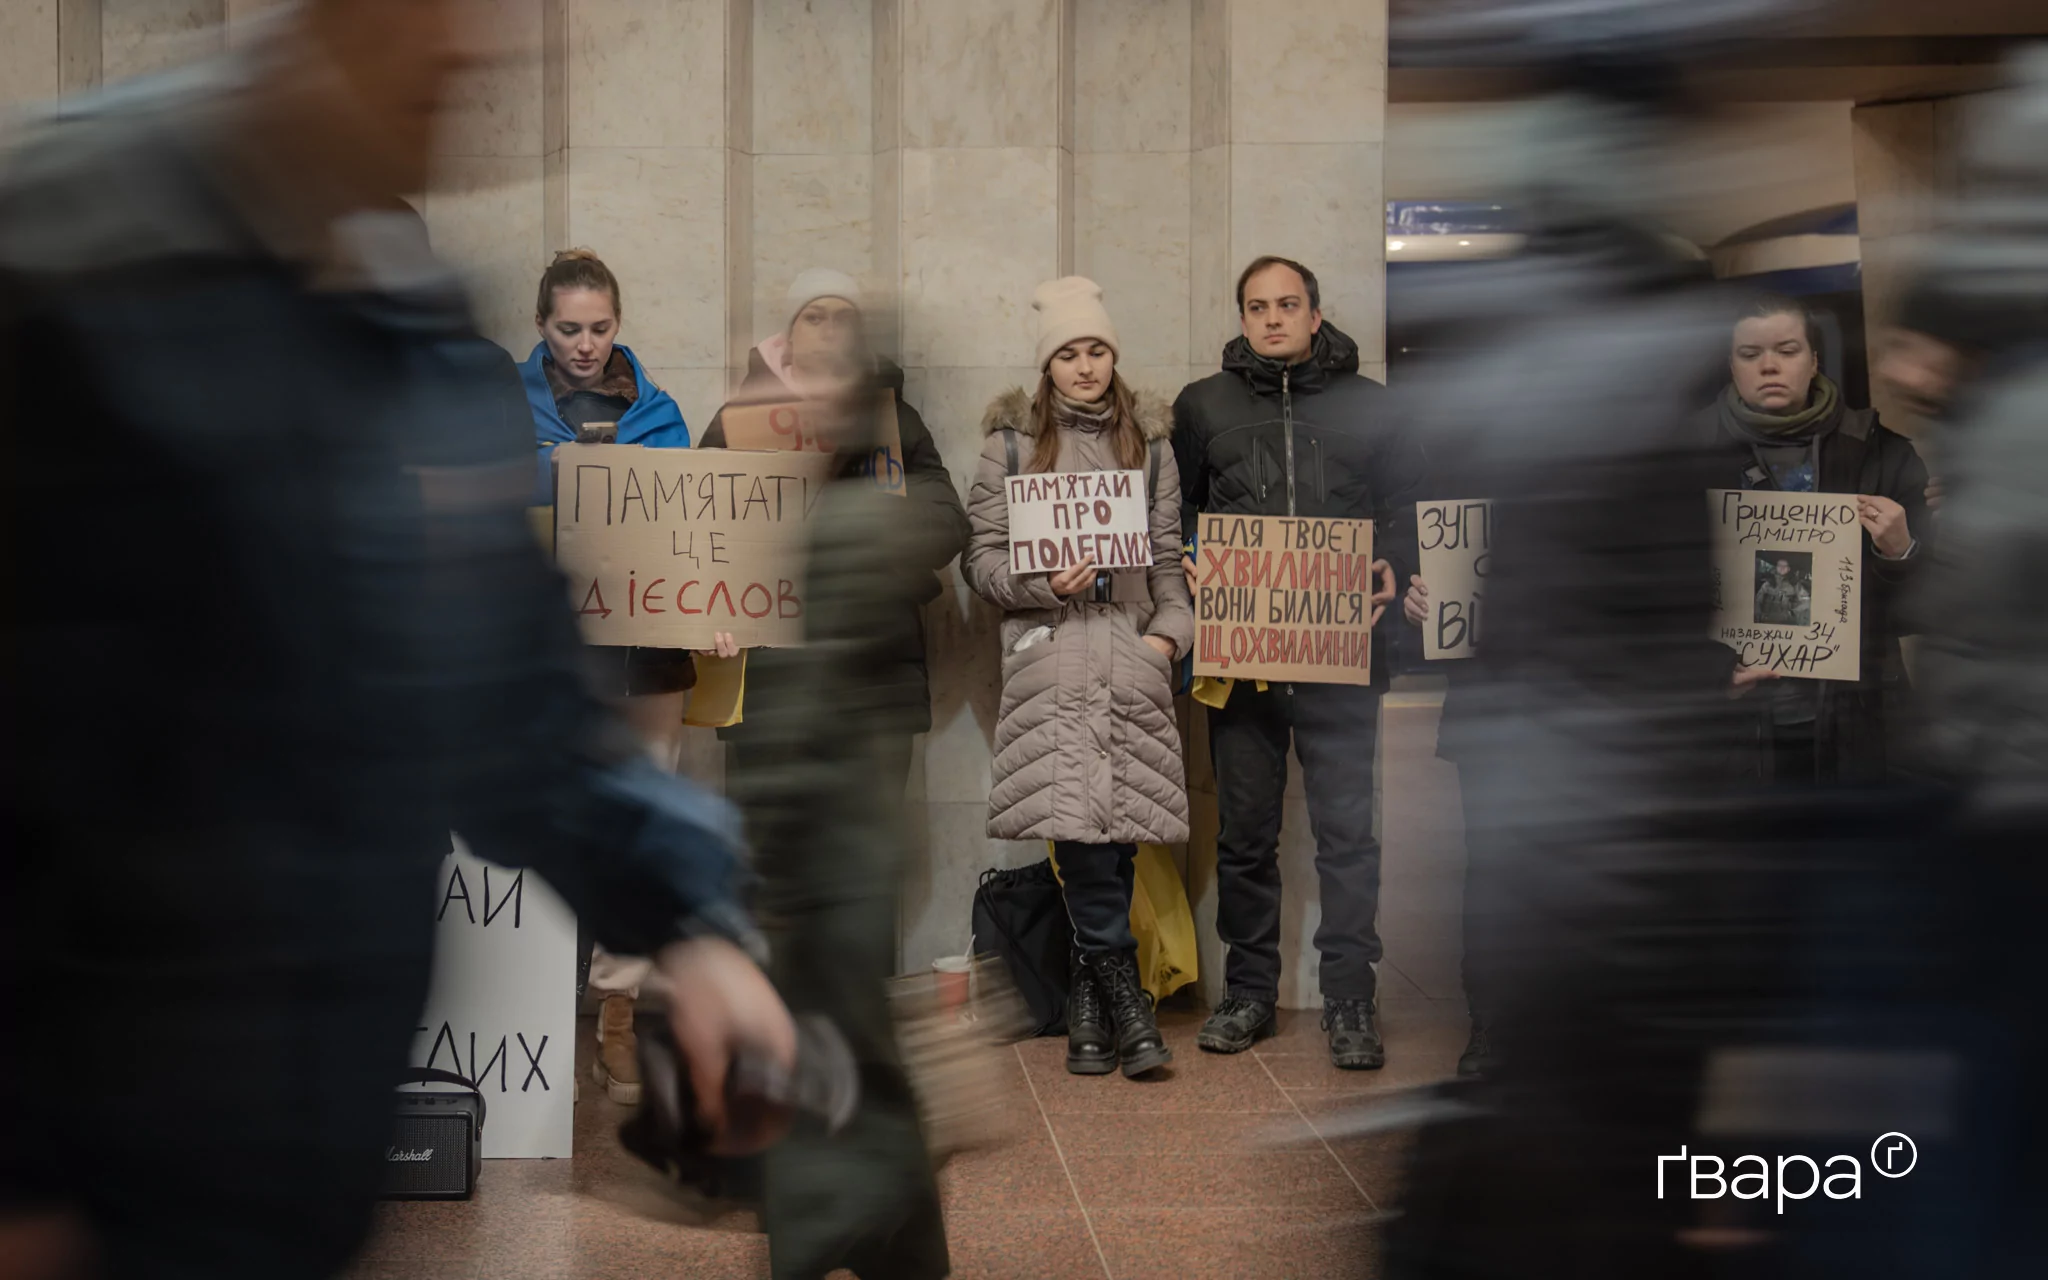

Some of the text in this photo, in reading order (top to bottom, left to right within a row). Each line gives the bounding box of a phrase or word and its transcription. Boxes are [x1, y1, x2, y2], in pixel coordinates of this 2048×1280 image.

[1053, 500, 1112, 530] ПРО
[1420, 503, 1494, 550] ЗУП
[672, 530, 730, 569] ЦЕ
[1013, 531, 1152, 571] ПОЛЕГЛИХ
[1202, 518, 1362, 553] ДЛЯ ТВОЄЇ
[1202, 549, 1367, 592] ХВИЛИНИ
[1838, 556, 1854, 581] 113
[578, 570, 804, 619] ДІЄСЛОВ
[1200, 586, 1363, 625] ВОНИ БИЛИСЯ
[1200, 624, 1369, 669] ЩОХВИЛИНИ
[414, 1020, 551, 1094] ЛИХ
